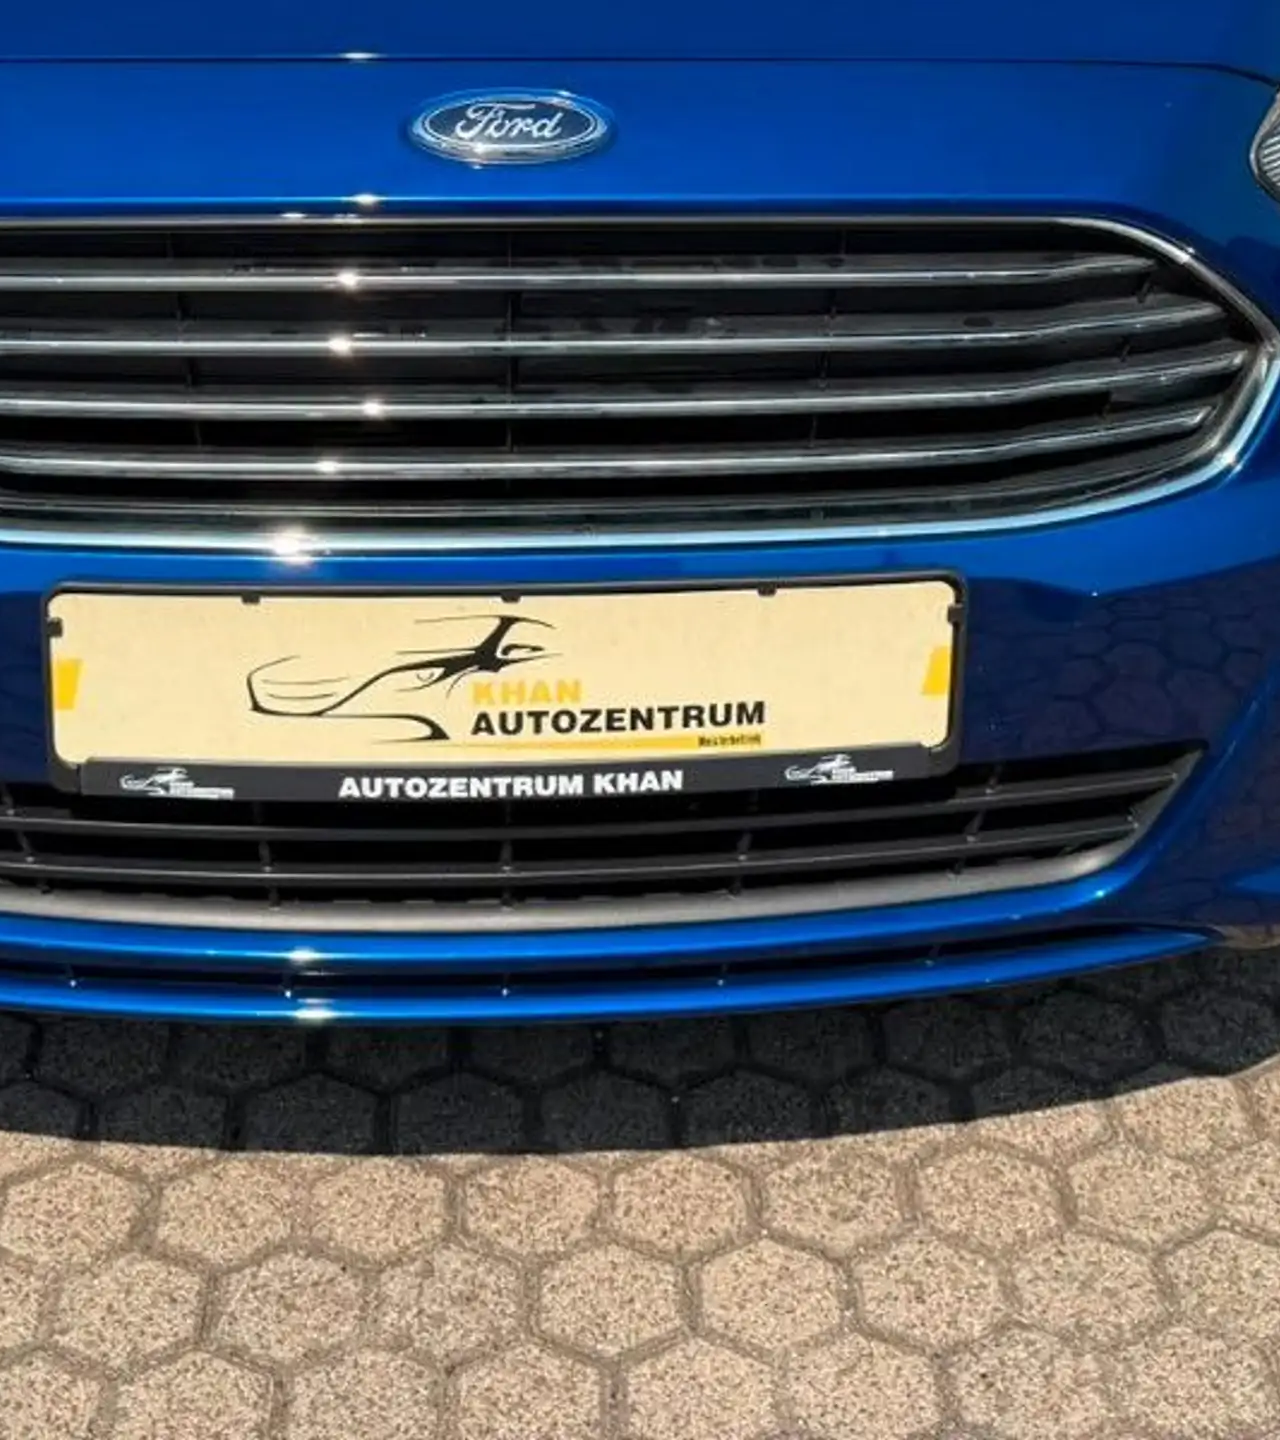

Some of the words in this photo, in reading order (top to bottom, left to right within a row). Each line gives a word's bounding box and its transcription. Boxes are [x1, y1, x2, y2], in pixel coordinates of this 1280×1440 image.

[455, 102, 564, 140] Ford
[471, 679, 582, 707] KHAN
[470, 700, 766, 737] AUTOZENTRUM
[337, 774, 584, 800] AUTOZENTRUM
[592, 769, 685, 795] KHAN
